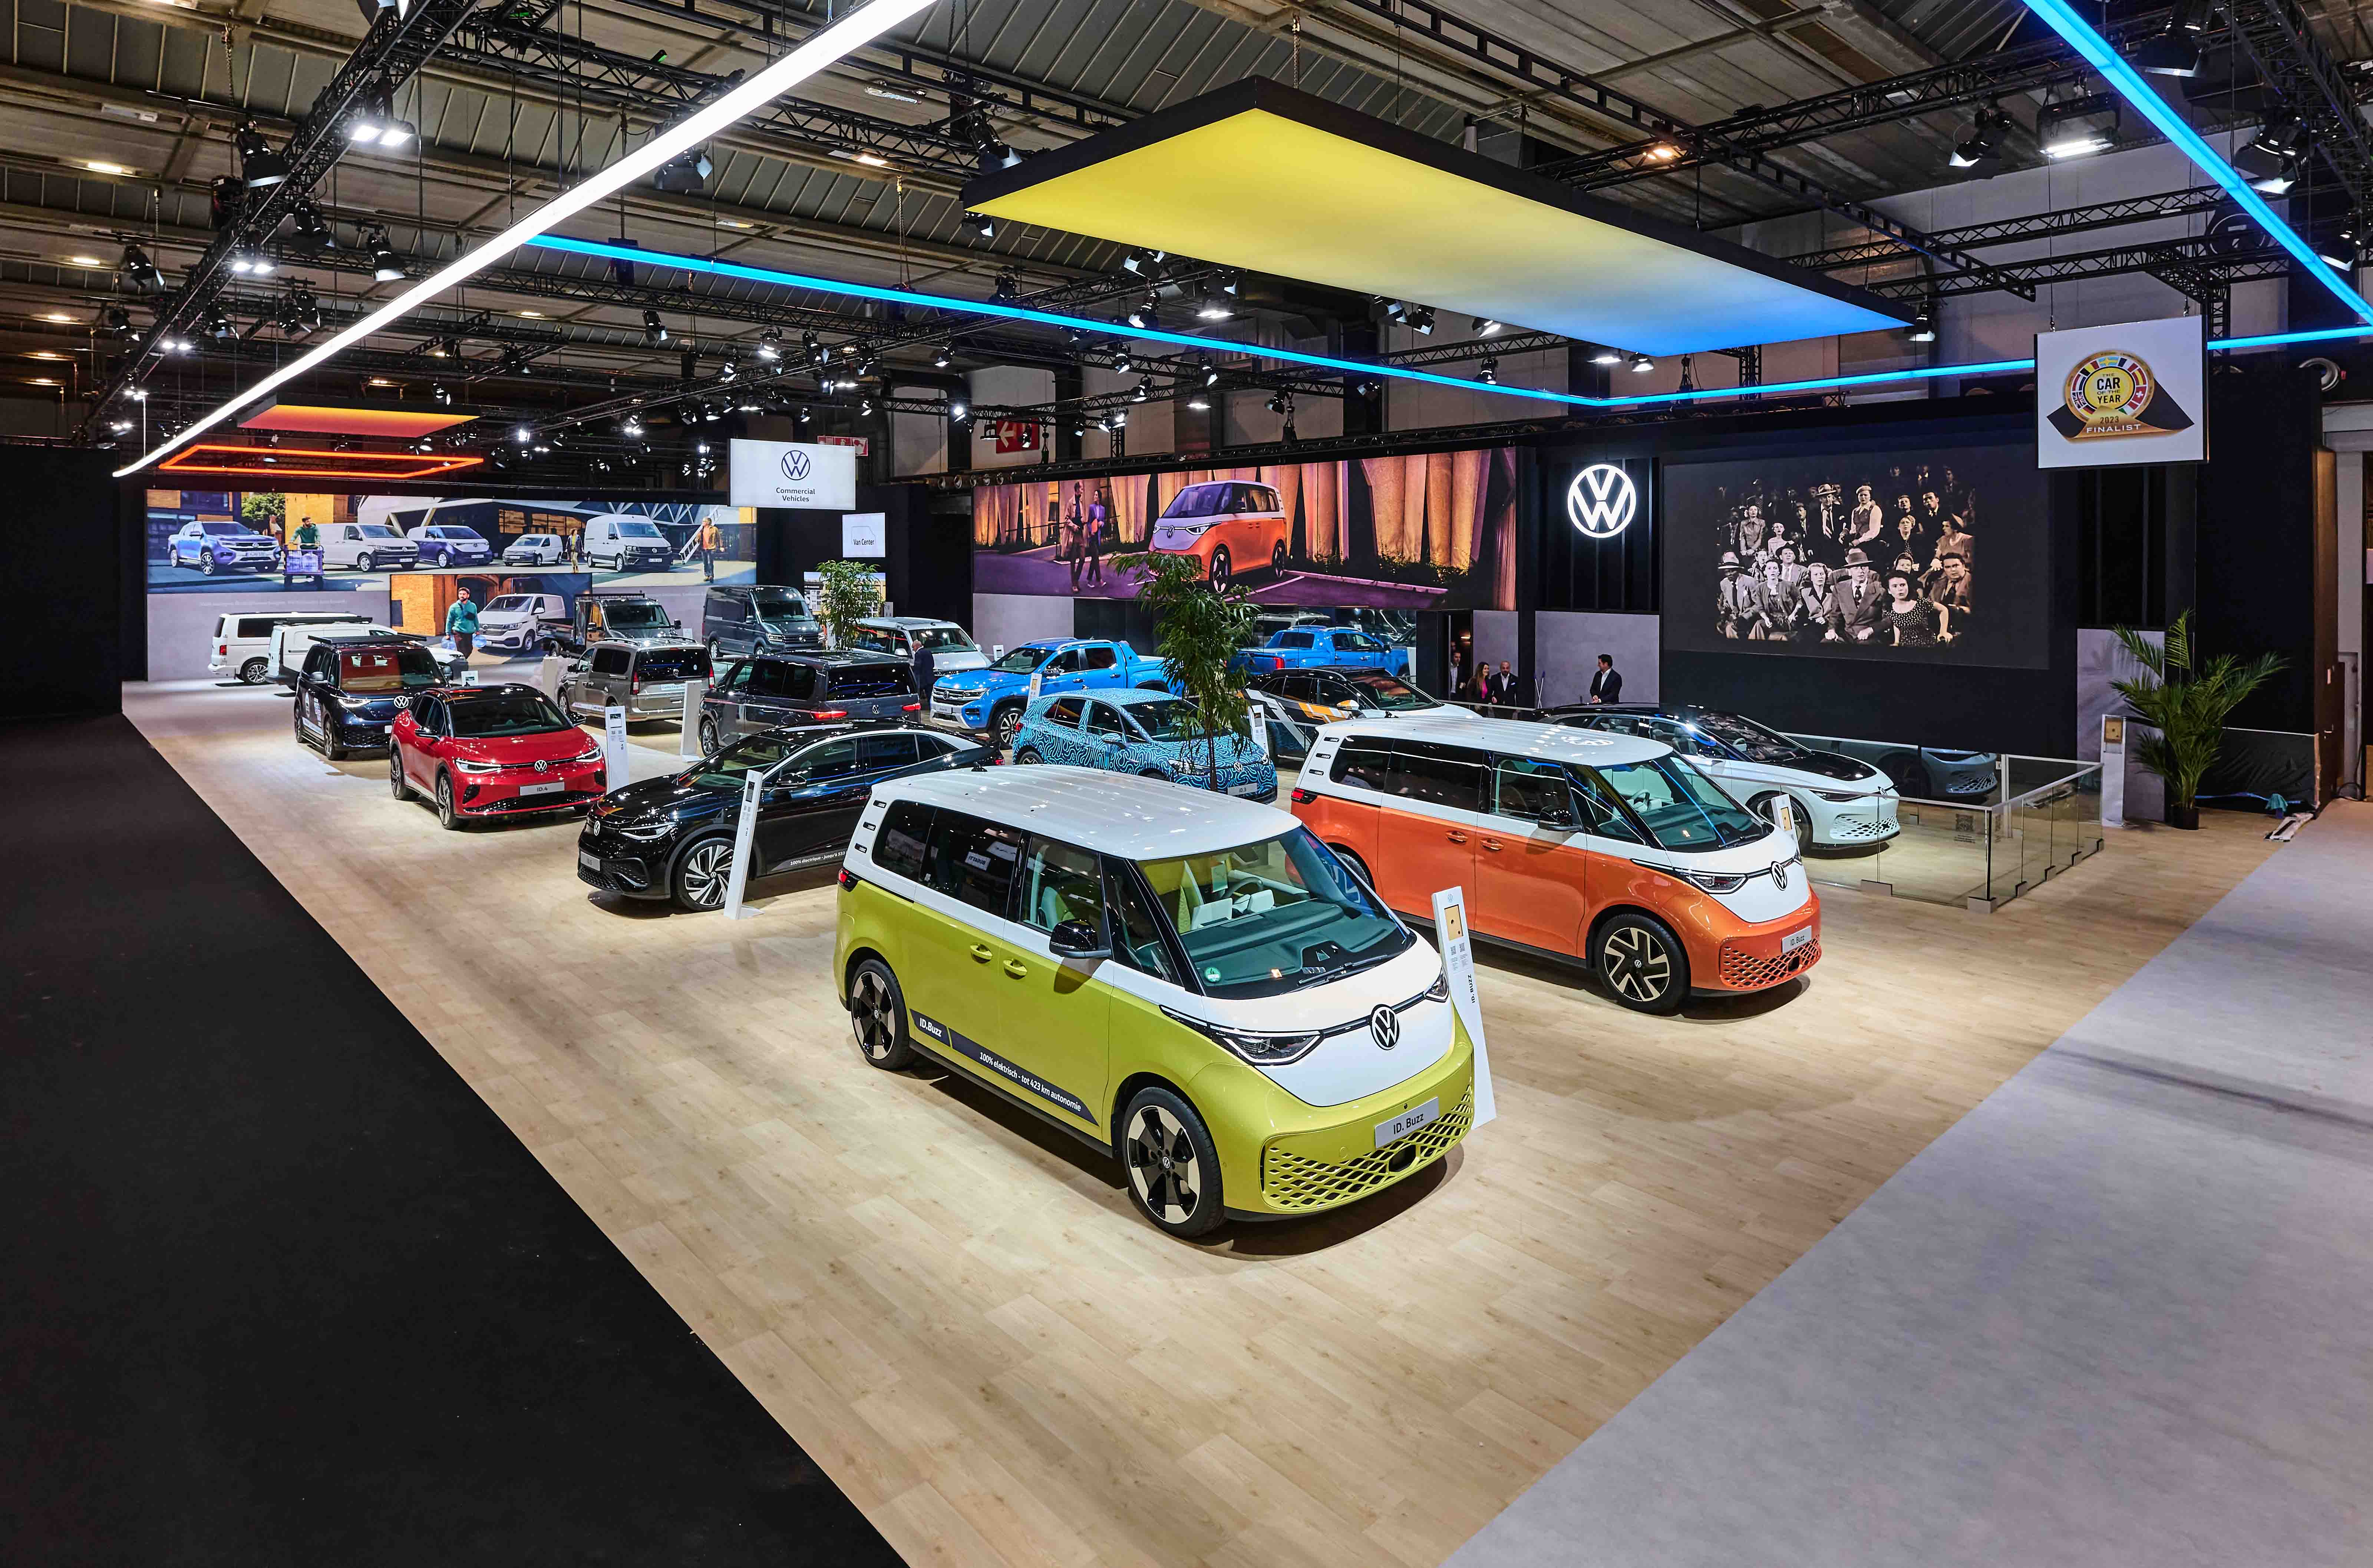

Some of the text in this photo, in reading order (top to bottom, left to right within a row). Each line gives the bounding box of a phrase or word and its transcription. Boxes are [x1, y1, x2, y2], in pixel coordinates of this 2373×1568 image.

[2097, 377, 2120, 390] CAR
[2097, 395, 2120, 404] YEAR
[2086, 424, 2141, 433] FINALIST
[781, 450, 810, 481] VW
[1567, 464, 1636, 538] VW
[1796, 935, 1805, 944] Buzz
[920, 1017, 942, 1037] ID.Buzz
[1370, 1004, 1400, 1050] VW
[980, 1052, 993, 1065] 100%
[993, 1061, 1017, 1079] elektrisch
[1021, 1075, 1030, 1086] tot
[1030, 1080, 1041, 1090] 423
[1041, 1084, 1050, 1096] km
[1050, 1092, 1081, 1112] autonomie
[1393, 1113, 1424, 1135] ID. Buzz
